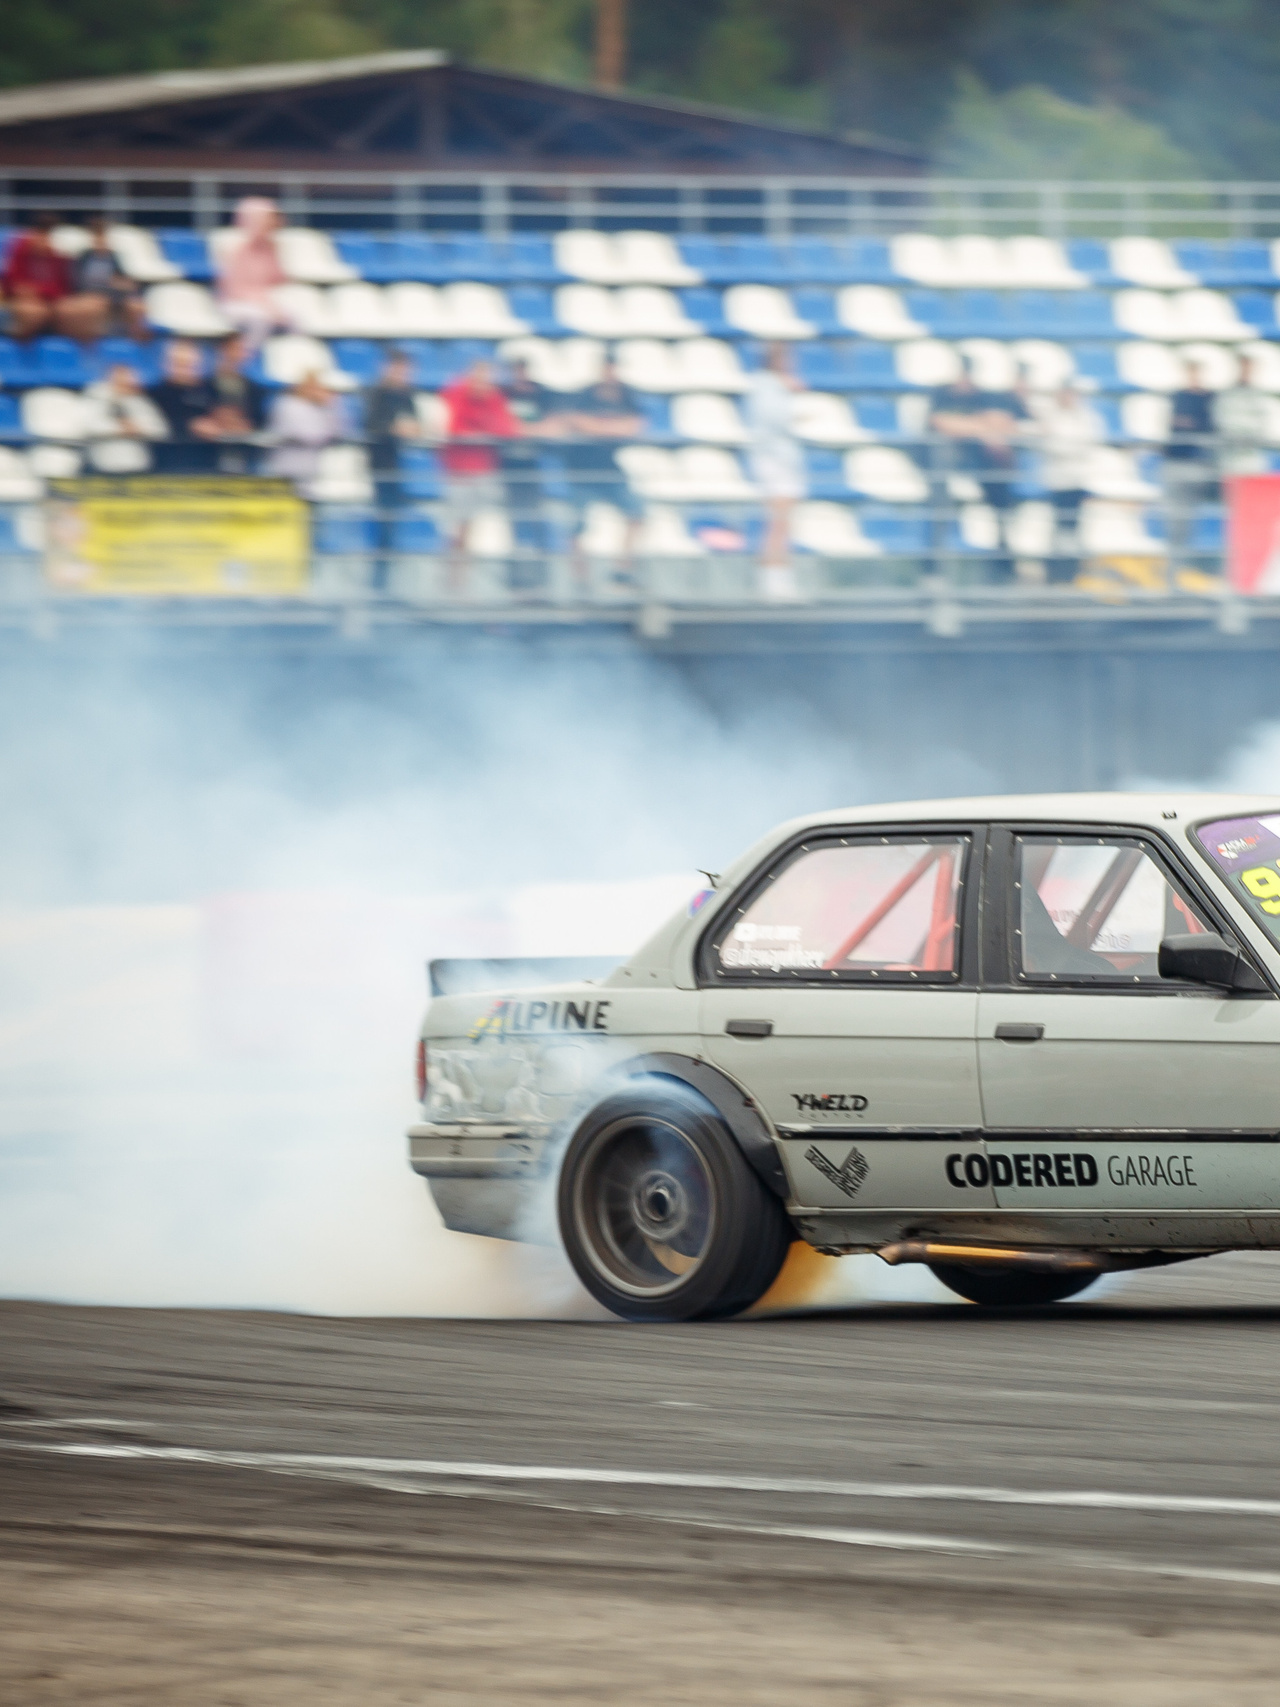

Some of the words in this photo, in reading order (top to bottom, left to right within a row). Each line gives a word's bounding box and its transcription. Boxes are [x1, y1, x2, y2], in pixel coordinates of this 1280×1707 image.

[467, 1000, 610, 1044] ALPINE
[945, 1153, 1098, 1187] CODERED
[1107, 1155, 1197, 1186] GARAGE
